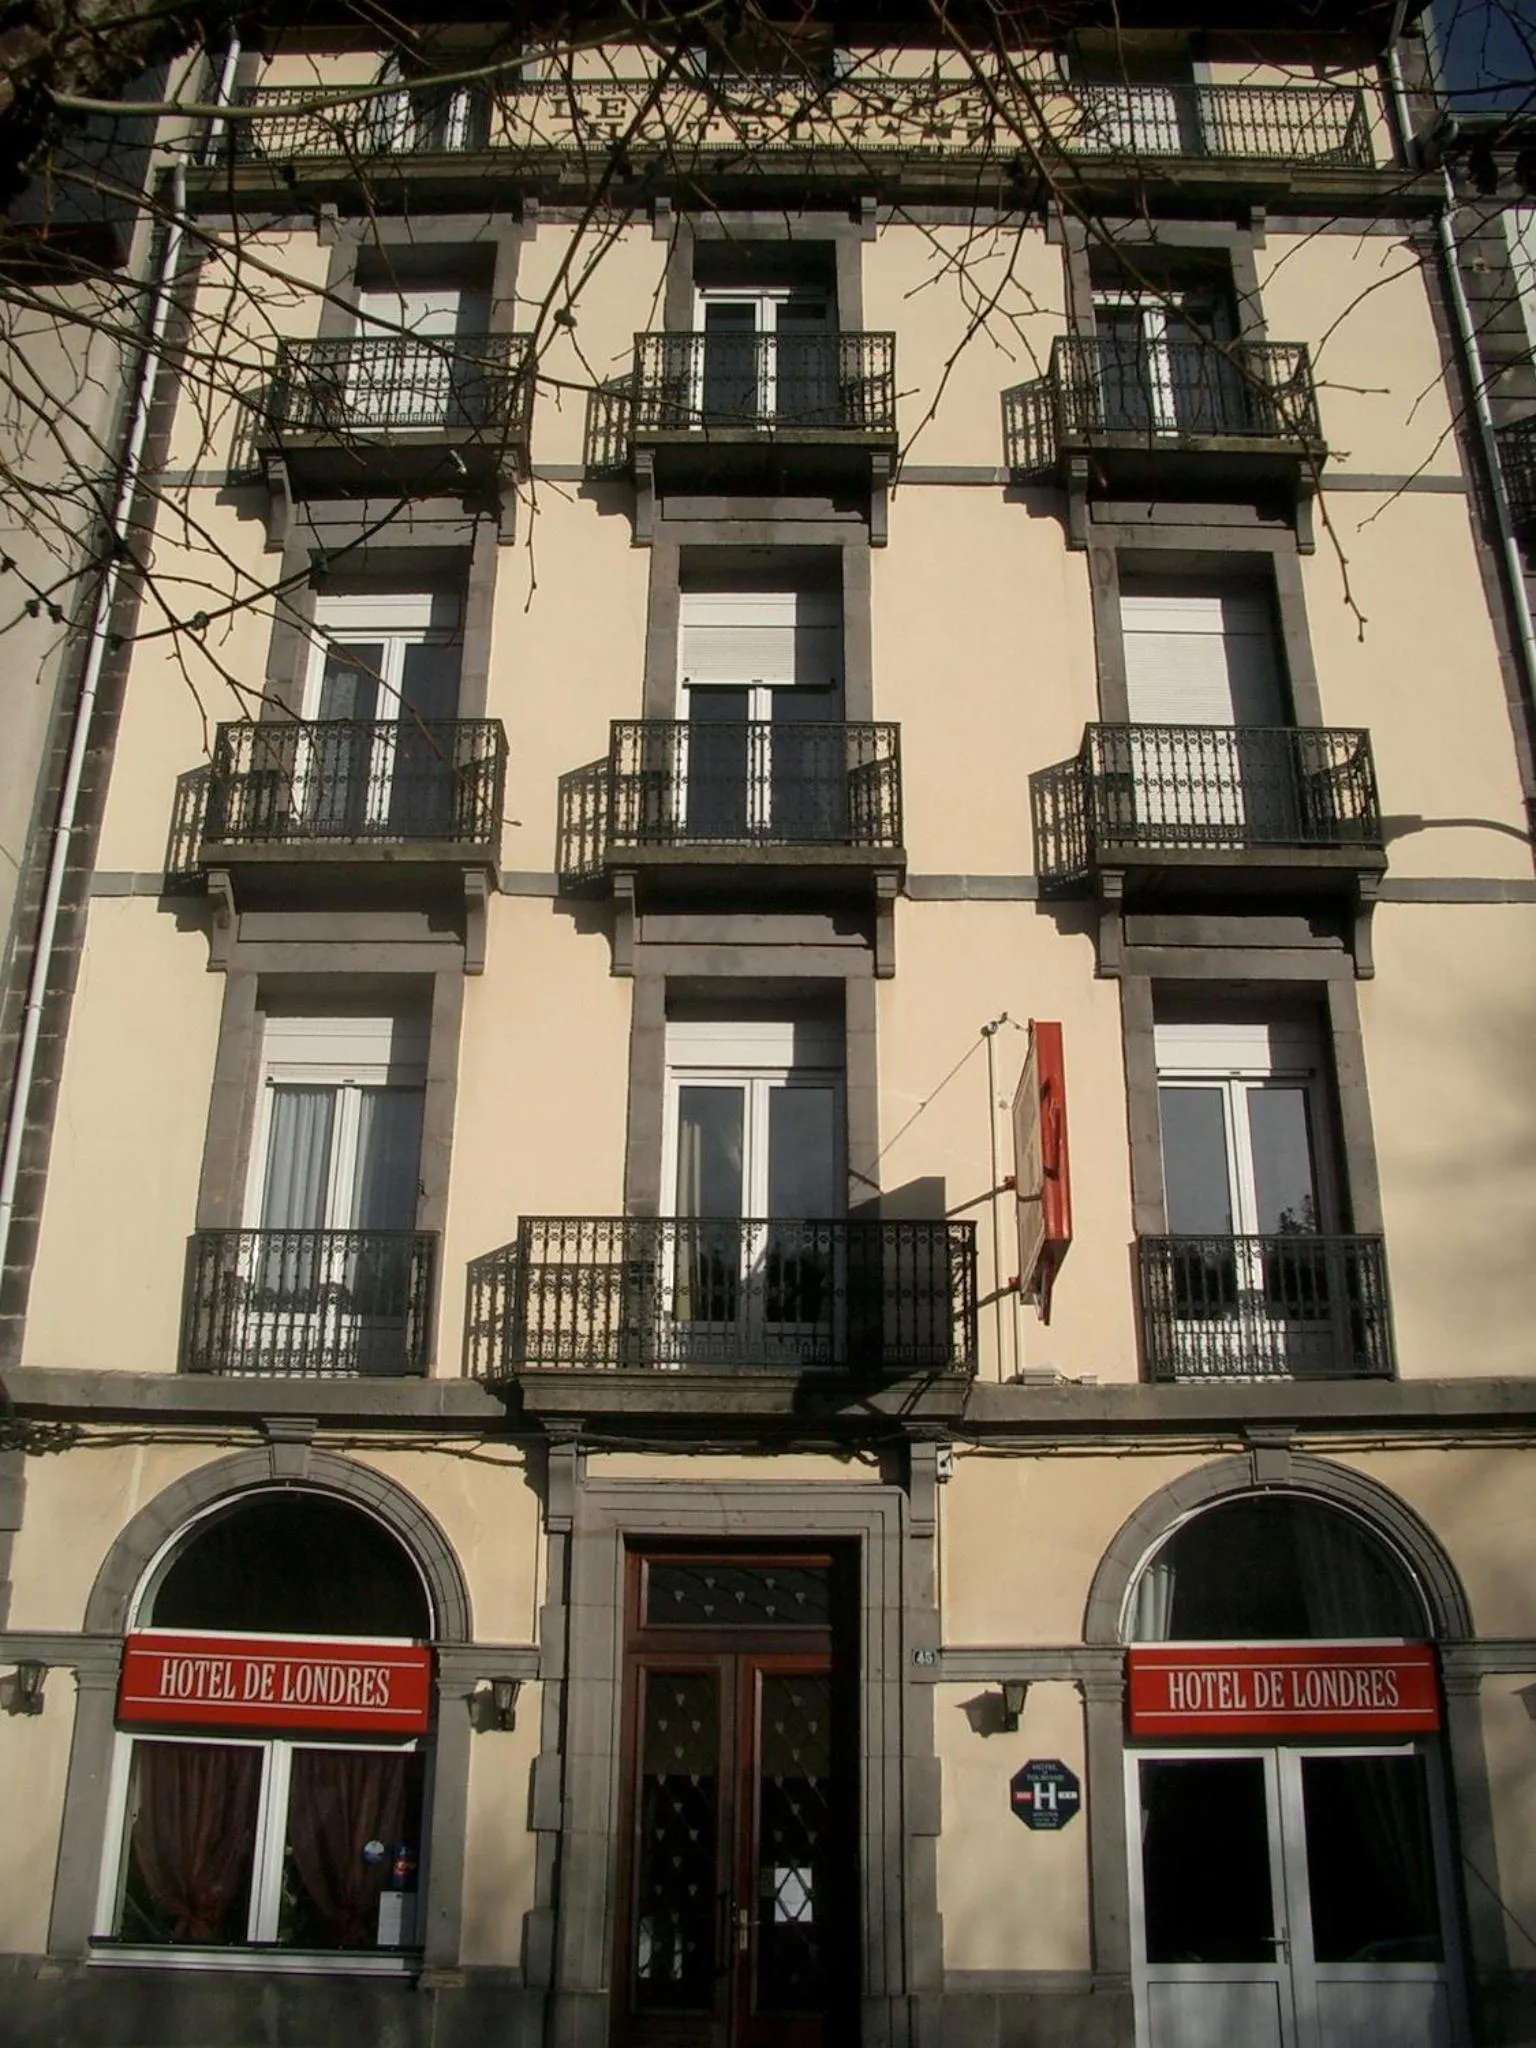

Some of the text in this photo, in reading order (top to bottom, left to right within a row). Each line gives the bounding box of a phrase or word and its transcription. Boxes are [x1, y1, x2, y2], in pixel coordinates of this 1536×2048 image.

[549, 98, 626, 119] LE
[584, 121, 814, 141] HOTEL
[160, 1658, 391, 1706] HOTEL DE LONDRES
[1168, 1669, 1400, 1709] HOTEL DE LONDRES
[1033, 1782, 1057, 1810] H
